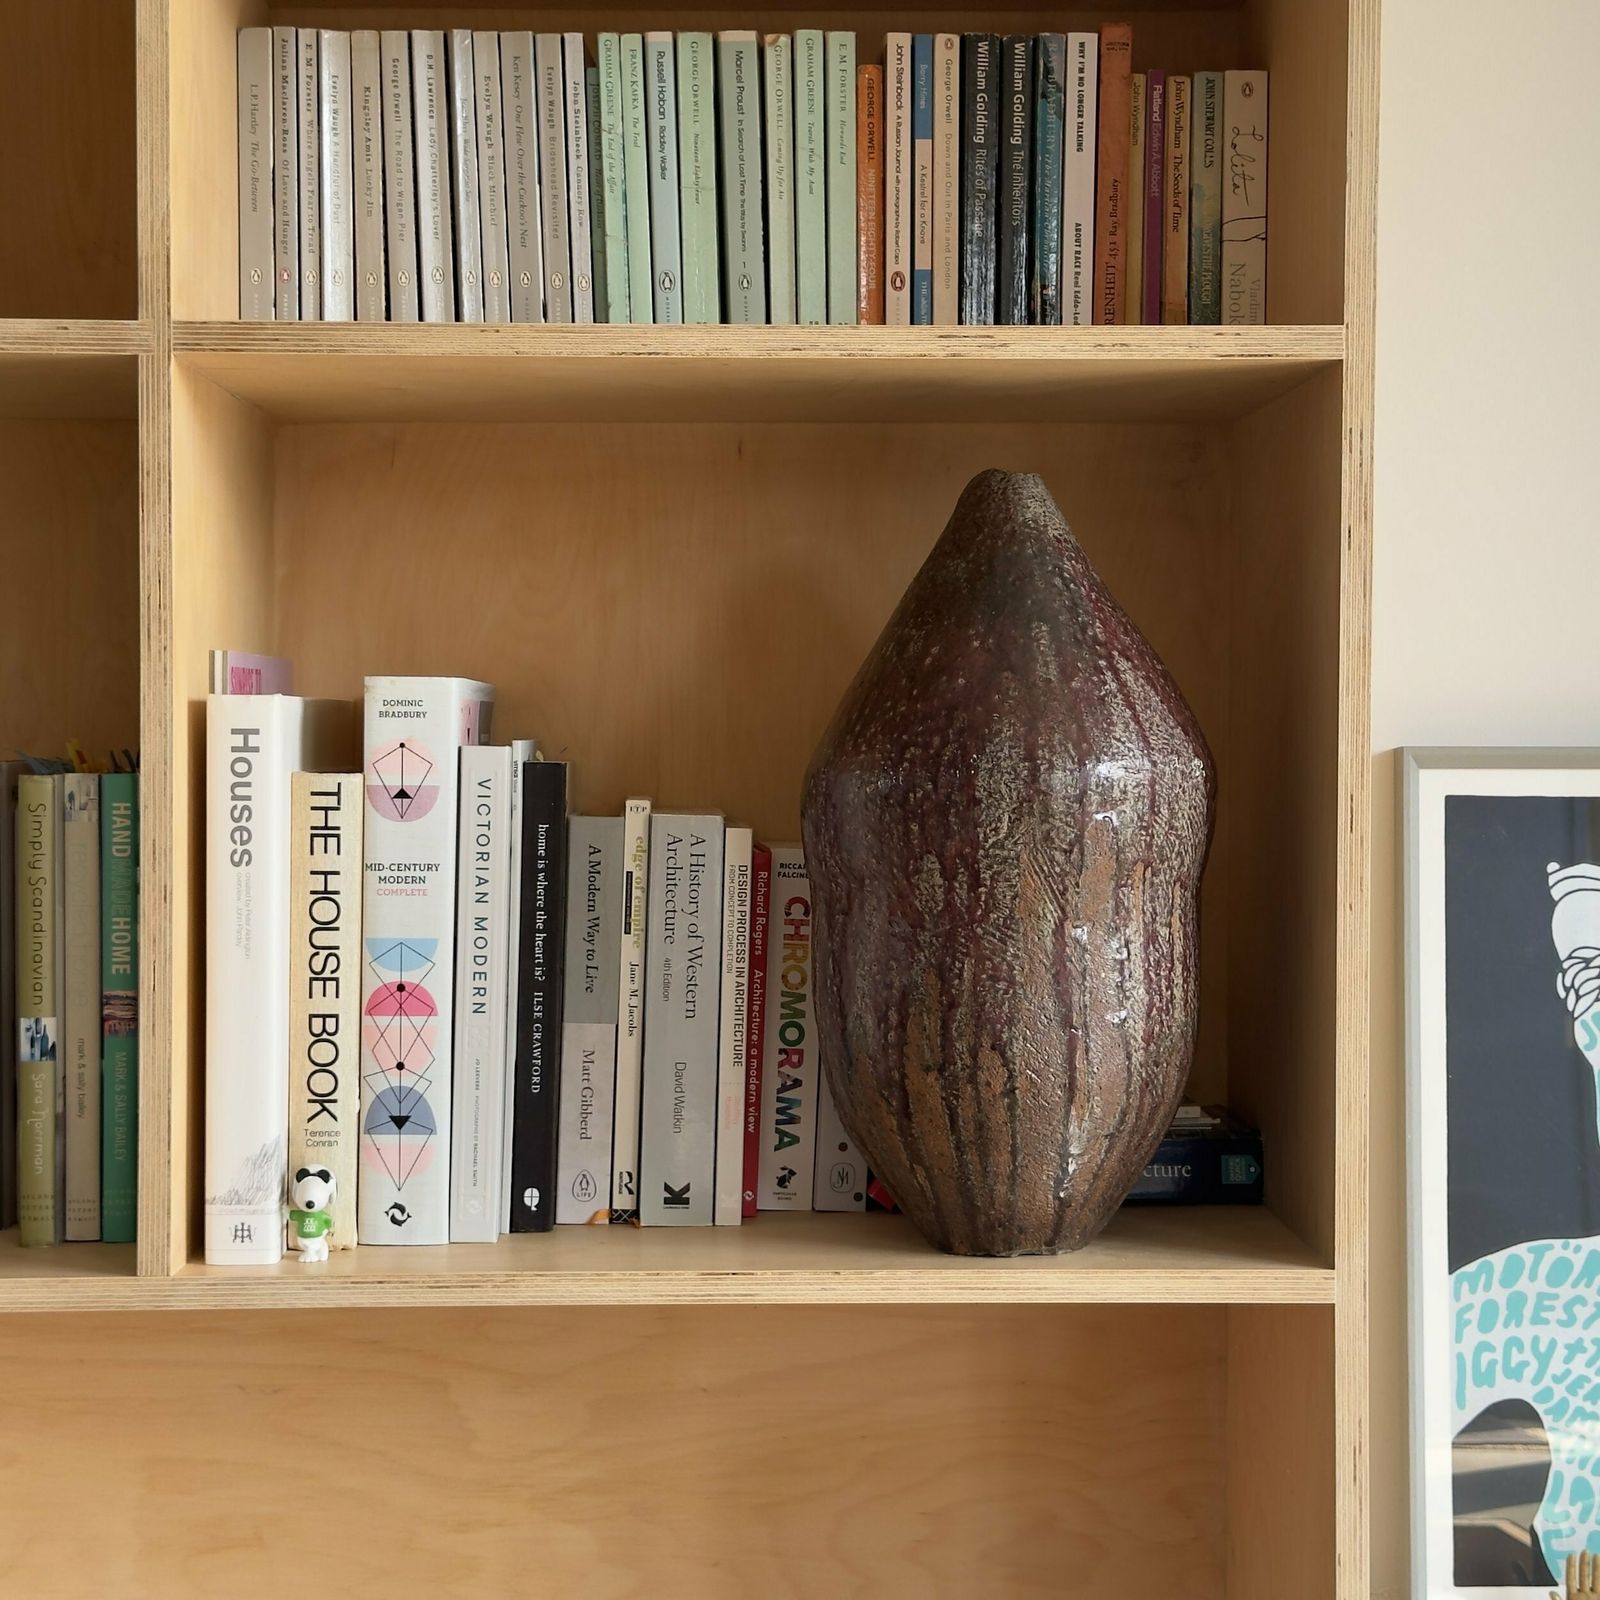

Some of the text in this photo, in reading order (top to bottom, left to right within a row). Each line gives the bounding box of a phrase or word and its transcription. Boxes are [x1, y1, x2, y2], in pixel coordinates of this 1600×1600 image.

[735, 50, 744, 84] Marcel
[895, 43, 904, 65] John
[896, 67, 904, 110] Steinbeck
[918, 64, 927, 85] Barry
[944, 59, 953, 92] George
[1078, 77, 1084, 87] NO
[363, 86, 372, 133] Kingsley
[657, 51, 668, 180] Russell Hoban Riddley Walker
[737, 86, 745, 115] Proust
[945, 94, 953, 124] Orwell
[1152, 85, 1162, 122] Flatland
[249, 102, 259, 136] Hartley
[1011, 42, 1025, 226] William Golding The Inheritors
[1076, 121, 1084, 152] TALKING
[251, 141, 260, 157] The
[512, 56, 528, 248] Ken Kesey One Flew Over the Cuckoo's Nest
[974, 41, 988, 237] William Golding Rites of Passage
[1152, 123, 1160, 151] Edwin
[895, 148, 903, 174] Journal
[1172, 80, 1184, 232] John Wyndham The Seeds of Time
[1230, 126, 1264, 206] Lolita
[251, 160, 260, 213] Go-Between
[365, 168, 373, 197] Lucky
[944, 182, 952, 197] Out
[1151, 164, 1160, 196] Abbott
[366, 200, 374, 218] Jim
[944, 200, 952, 209] in
[944, 212, 952, 233] Paris
[944, 236, 952, 253] and
[944, 256, 952, 289] London
[378, 710, 428, 718] BRADBURY
[382, 699, 424, 707] DOMINIC
[230, 727, 261, 868] Houses
[365, 863, 440, 872] MID-CENTURY
[378, 876, 426, 884] MODERN
[28, 803, 46, 1005] Simply Scandinavian
[376, 888, 428, 896] COMPLETE
[472, 779, 492, 1014] VICTORIAN MODERN
[727, 885, 735, 919] CONCEPT
[756, 872, 767, 913] Richard
[583, 844, 601, 993] A Modern Way to Live
[662, 834, 683, 1002] Architecture 4th Edition
[681, 834, 706, 1019] A History of Western
[727, 920, 734, 928] TO
[306, 782, 341, 1123] THE HOUSE BOOK
[627, 837, 645, 1037] edge of empire Jane M. Jacobs
[726, 930, 734, 974] COMPLETION
[752, 917, 765, 956] Rogers
[531, 824, 549, 1093] home is where the heart is? ILSE CRAWFORD
[733, 865, 748, 1068] DESIGN PROCESS IN ARCHITECTURE
[750, 970, 763, 1045] Architecture:
[774, 896, 810, 1152] CHROMORAMA
[32, 1073, 45, 1104] Sara
[579, 1050, 595, 1140] Matt Gibberd
[673, 1062, 686, 1134] David Watkin
[748, 1059, 758, 1102] modern
[115, 1052, 126, 1161] MARK & SALLY BAILEY
[748, 1106, 757, 1133] view
[27, 1111, 48, 1174] Norrman
[304, 1128, 341, 1138] Terence
[306, 1139, 338, 1148] Conran
[1456, 1335, 1558, 1410] IGGY
